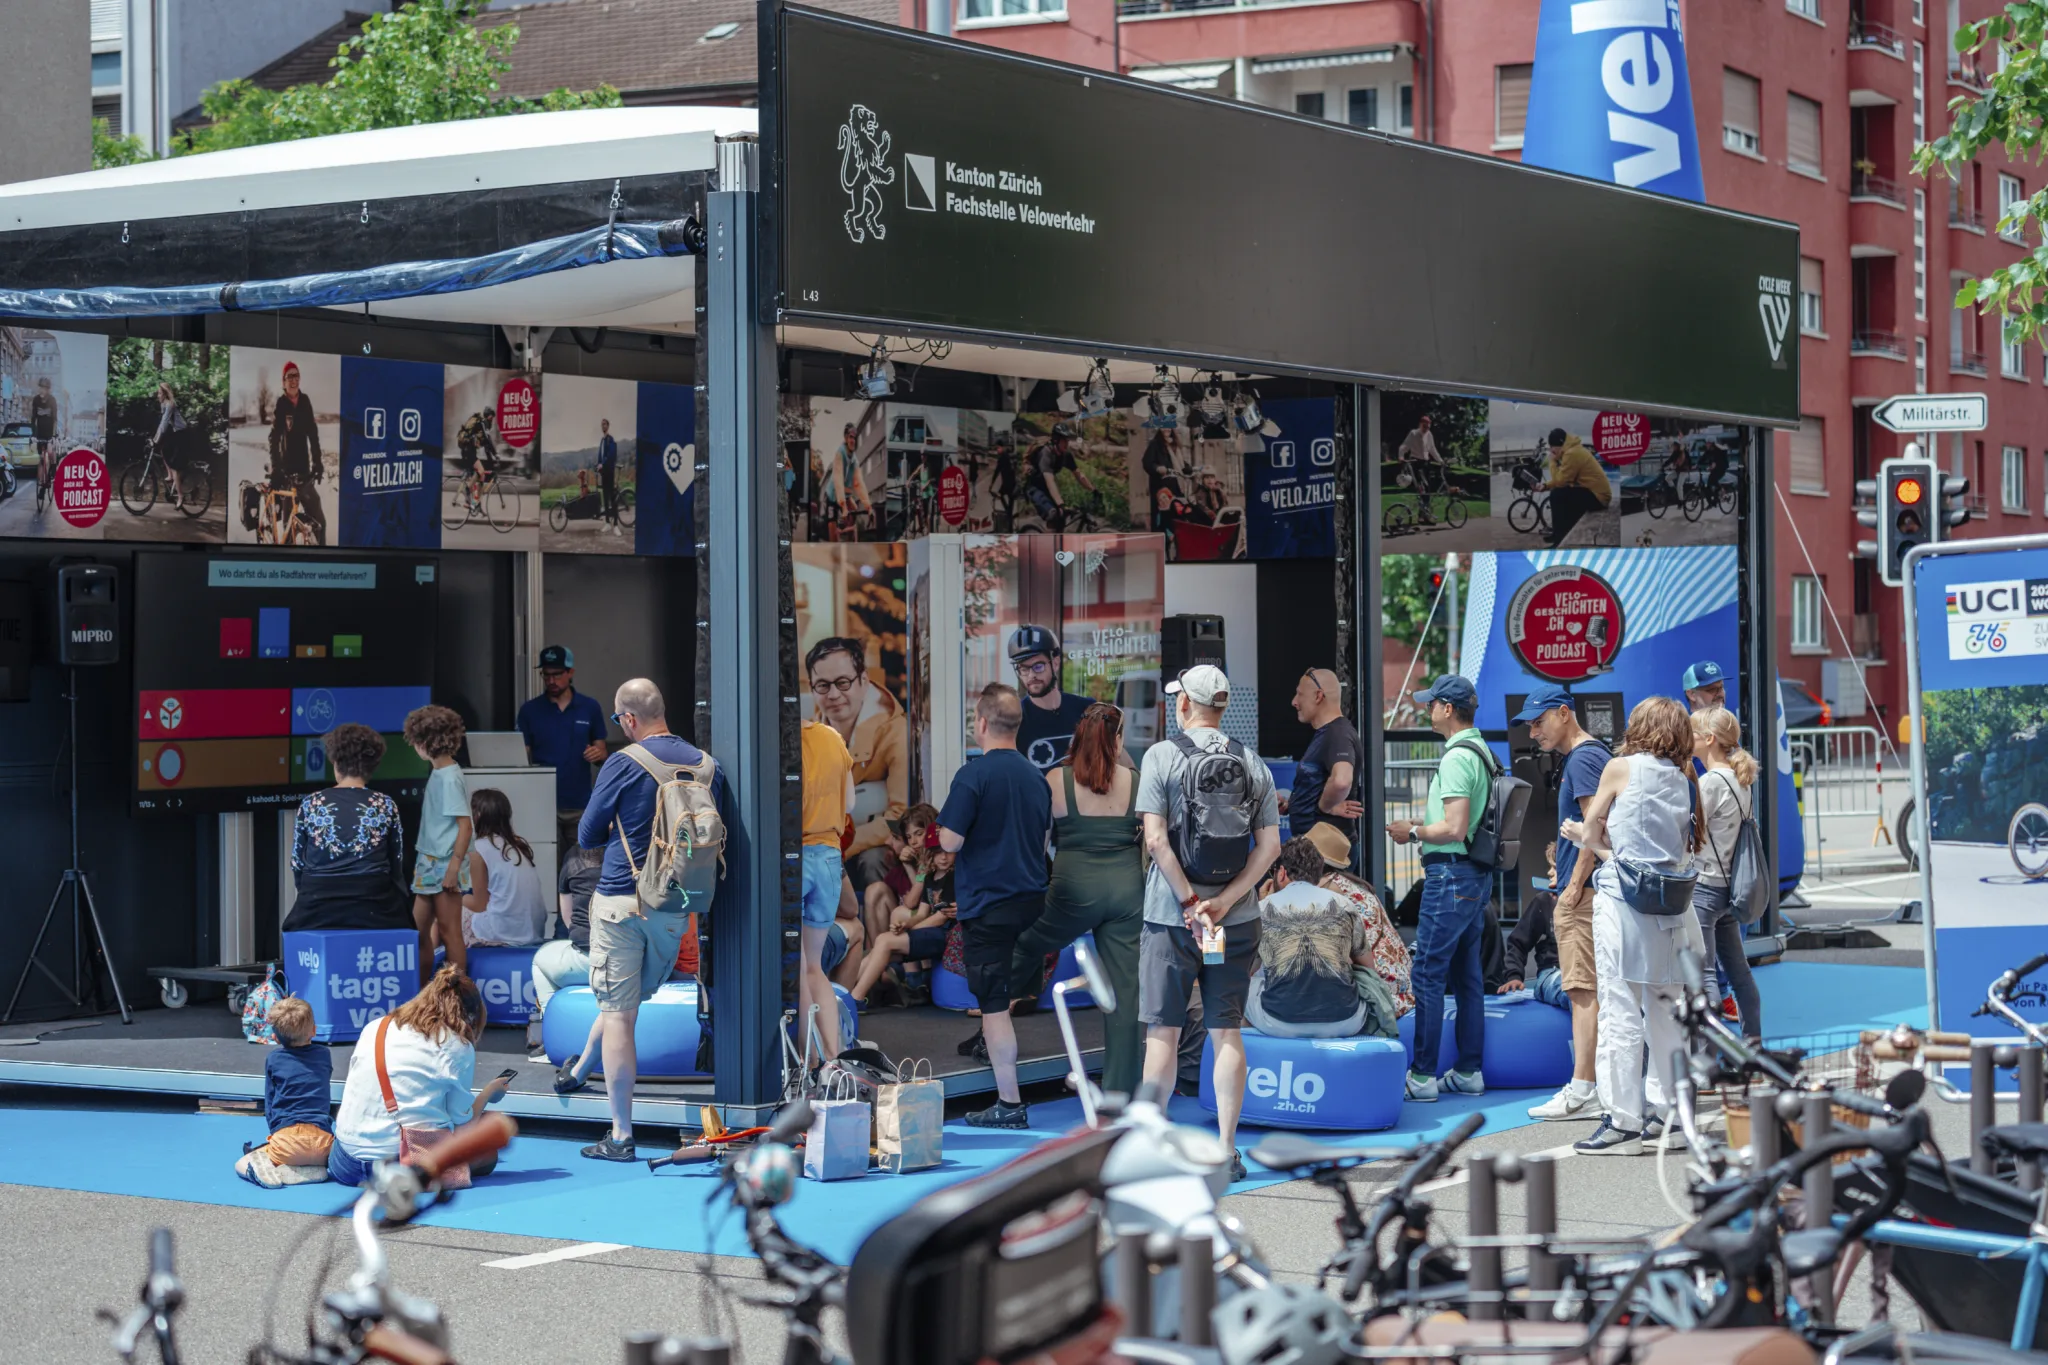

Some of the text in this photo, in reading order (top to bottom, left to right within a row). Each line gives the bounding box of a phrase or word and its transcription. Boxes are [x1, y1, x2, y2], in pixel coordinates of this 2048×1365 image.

[946, 161, 1042, 196] Kanton Zürich
[946, 191, 1095, 234] Fachstelle Veloverkehr
[1759, 274, 1791, 296] CYCLE WEEK
[809, 290, 819, 301] 43
[503, 392, 520, 405] NEU
[503, 413, 534, 429] PODCAST
[1601, 415, 1622, 428] NEU
[1902, 407, 1971, 421] Militärstr.
[1601, 432, 1643, 450] PODCAST
[63, 465, 84, 479] NEU
[353, 460, 423, 488] @VELO.ZH.CH
[63, 489, 103, 507] PODCAST
[218, 568, 367, 581] Wo darfst du als Radfahrer weiterfahren?
[1534, 598, 1607, 616] GESCHICHTEN
[1960, 587, 2020, 614] UCI
[1546, 616, 1565, 631] .CH
[72, 624, 113, 642] MIPRO
[1068, 634, 1157, 659] GESCHICHTEN
[1537, 642, 1588, 660] PODCAST
[1084, 657, 1105, 677] .CH
[252, 795, 280, 803] kahoot.it
[298, 947, 319, 969] velo
[356, 943, 416, 973] #all
[328, 973, 400, 1004] tags
[2012, 999, 2035, 1008] von
[1247, 1060, 1325, 1103] elo
[1273, 1100, 1315, 1113] .zh.ch
